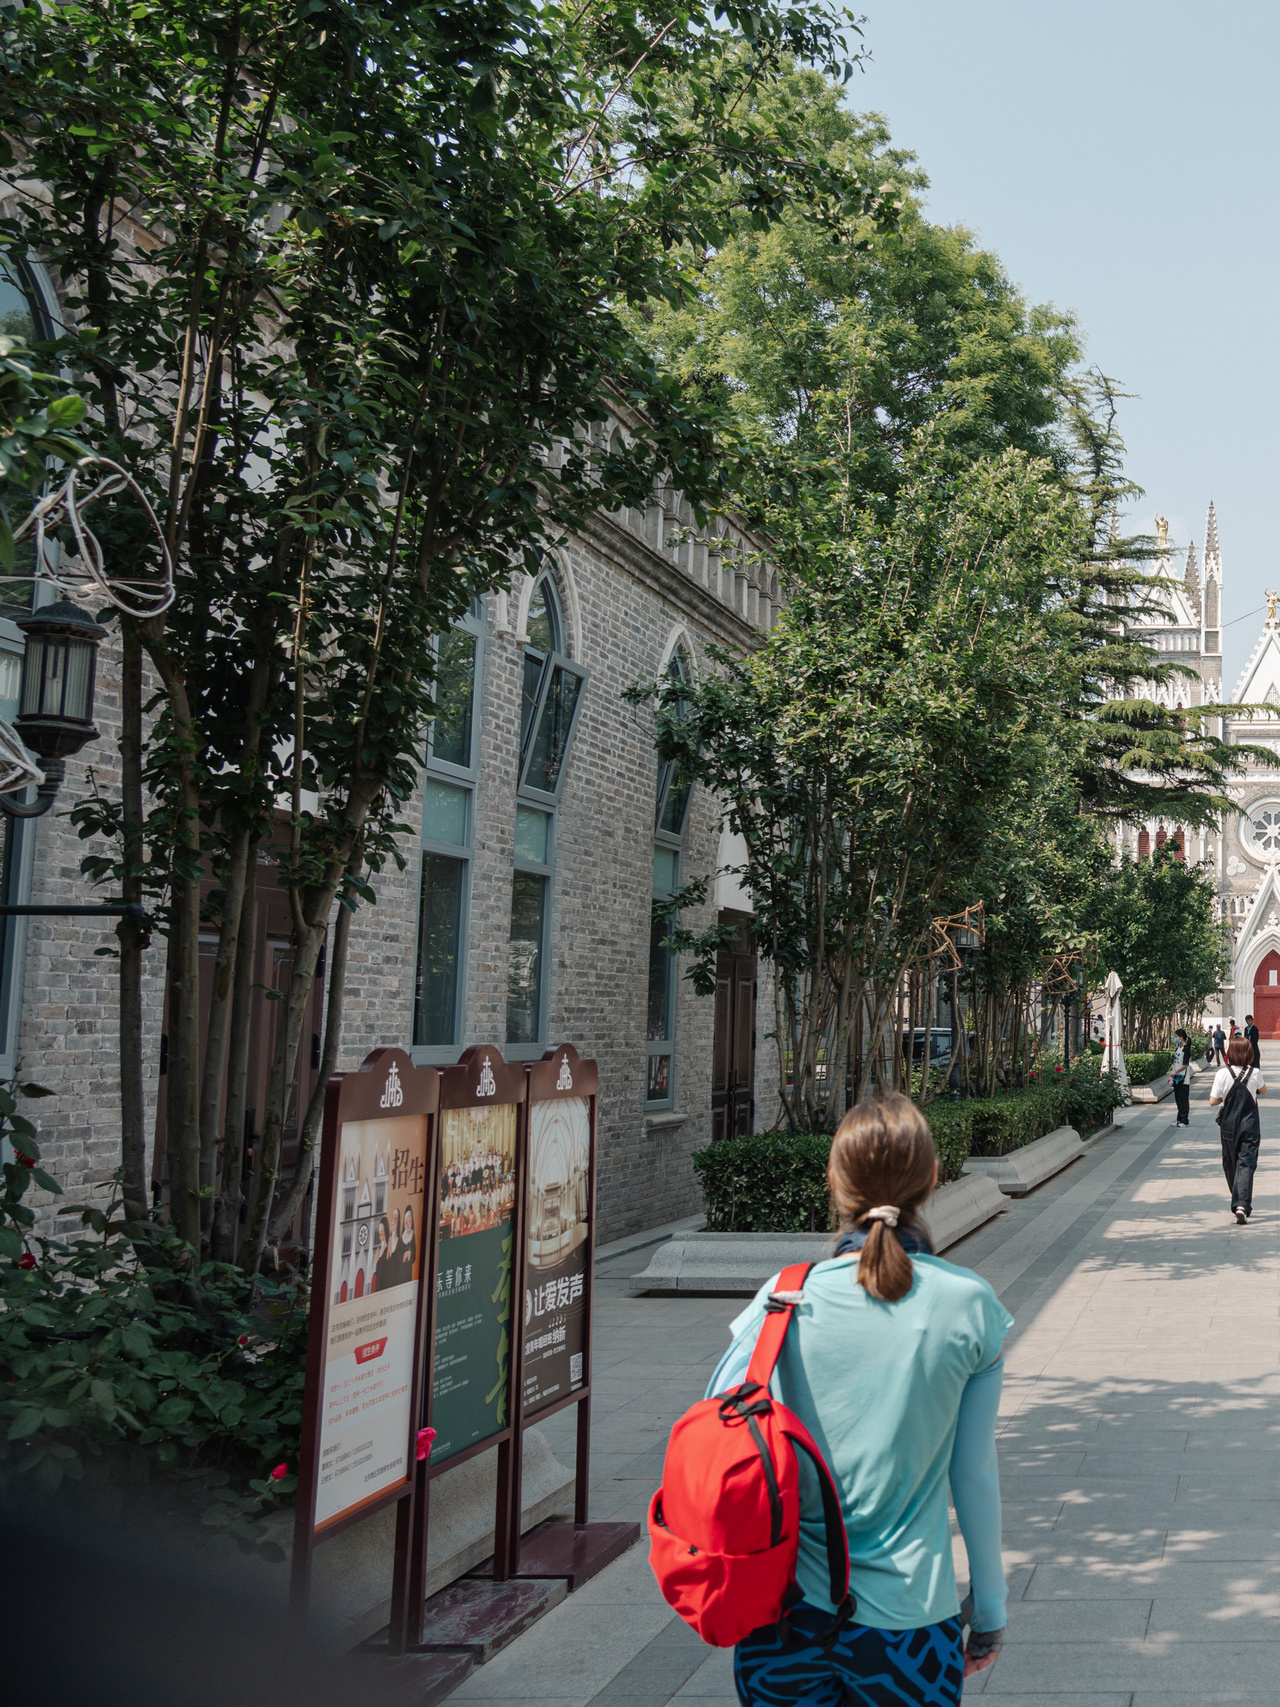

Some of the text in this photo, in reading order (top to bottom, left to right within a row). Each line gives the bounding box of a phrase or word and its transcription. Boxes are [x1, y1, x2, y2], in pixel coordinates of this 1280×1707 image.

[392, 1148, 424, 1196] 招生
[534, 1273, 584, 1317] 让爱发声
[362, 1343, 381, 1358] 招生条件
